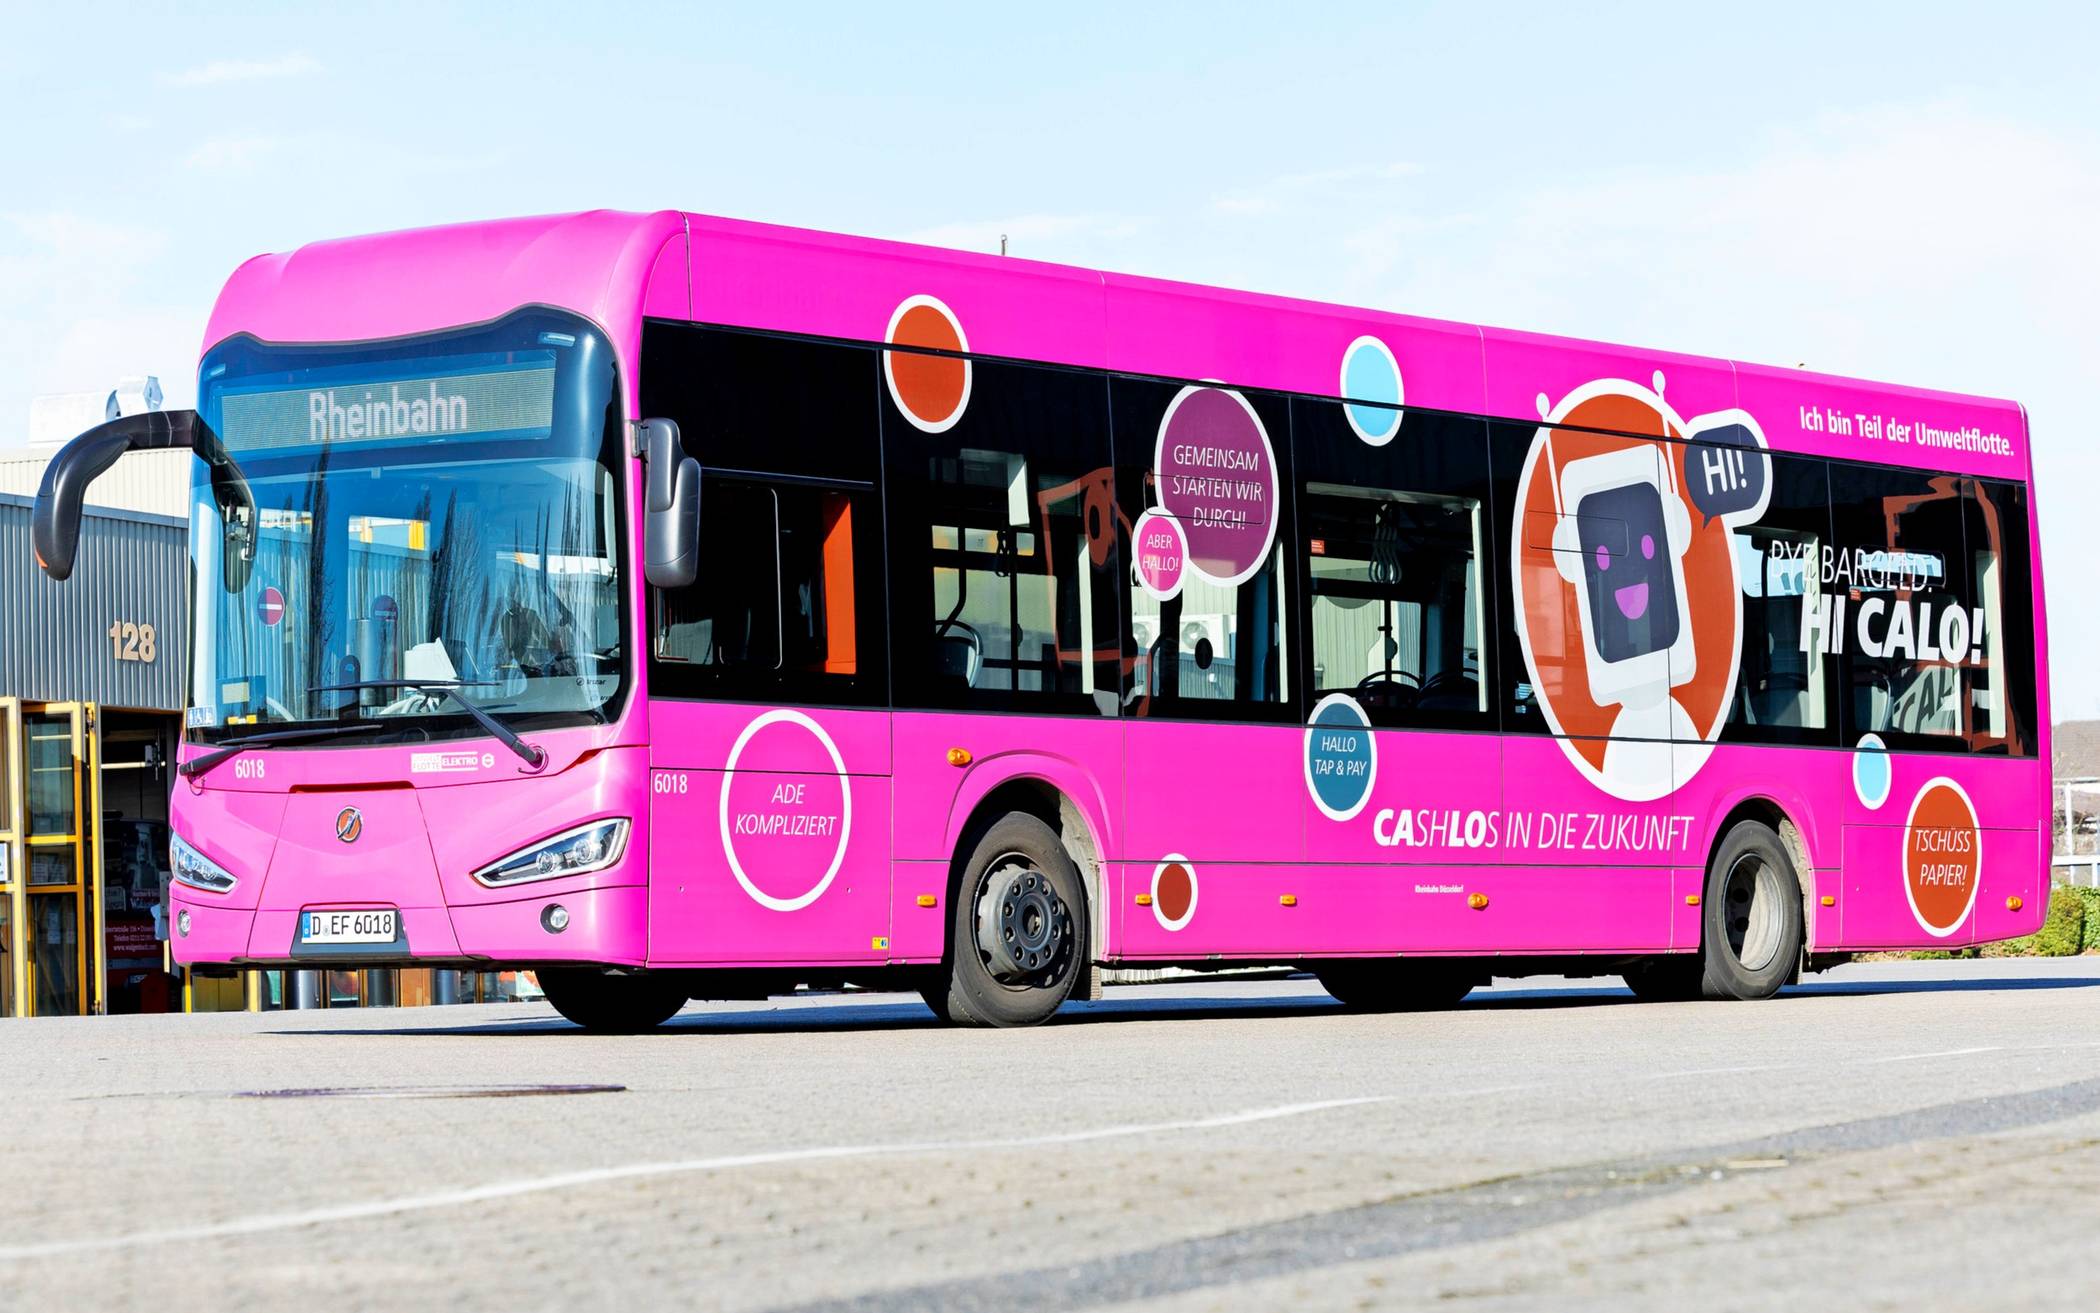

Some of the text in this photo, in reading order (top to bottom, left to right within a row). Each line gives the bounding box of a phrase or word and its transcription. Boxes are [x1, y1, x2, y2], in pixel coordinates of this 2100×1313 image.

[309, 382, 467, 441] Rheinbahn
[1800, 406, 2014, 456] Ich bin Teil der Umweltflotte.
[1173, 444, 1259, 472] GEMEINSAM
[1702, 447, 1748, 496] HI!
[1172, 474, 1262, 502] STARTEN WIR
[1193, 506, 1246, 531] DURCH!
[1146, 533, 1173, 550] ABER
[1142, 555, 1179, 572] HALLO!
[1821, 544, 1933, 593] BARGELD.
[1799, 591, 1985, 666] HI CALO!
[109, 619, 156, 663] 128
[1321, 735, 1357, 752] HALLO
[235, 758, 265, 779] 6018
[442, 756, 478, 768] ELEKTRO
[1315, 759, 1368, 776] TAP & PAY
[654, 773, 688, 794] 6018
[771, 783, 806, 804] ADE
[735, 813, 837, 836] KOMPLIZIERT
[1373, 808, 1695, 852] CASHLOS IN DIE ZUKUNFT
[1915, 826, 1971, 853] TSCHÜSS
[1920, 863, 1968, 887] PAPIER!
[312, 913, 392, 936] D EF 6018
